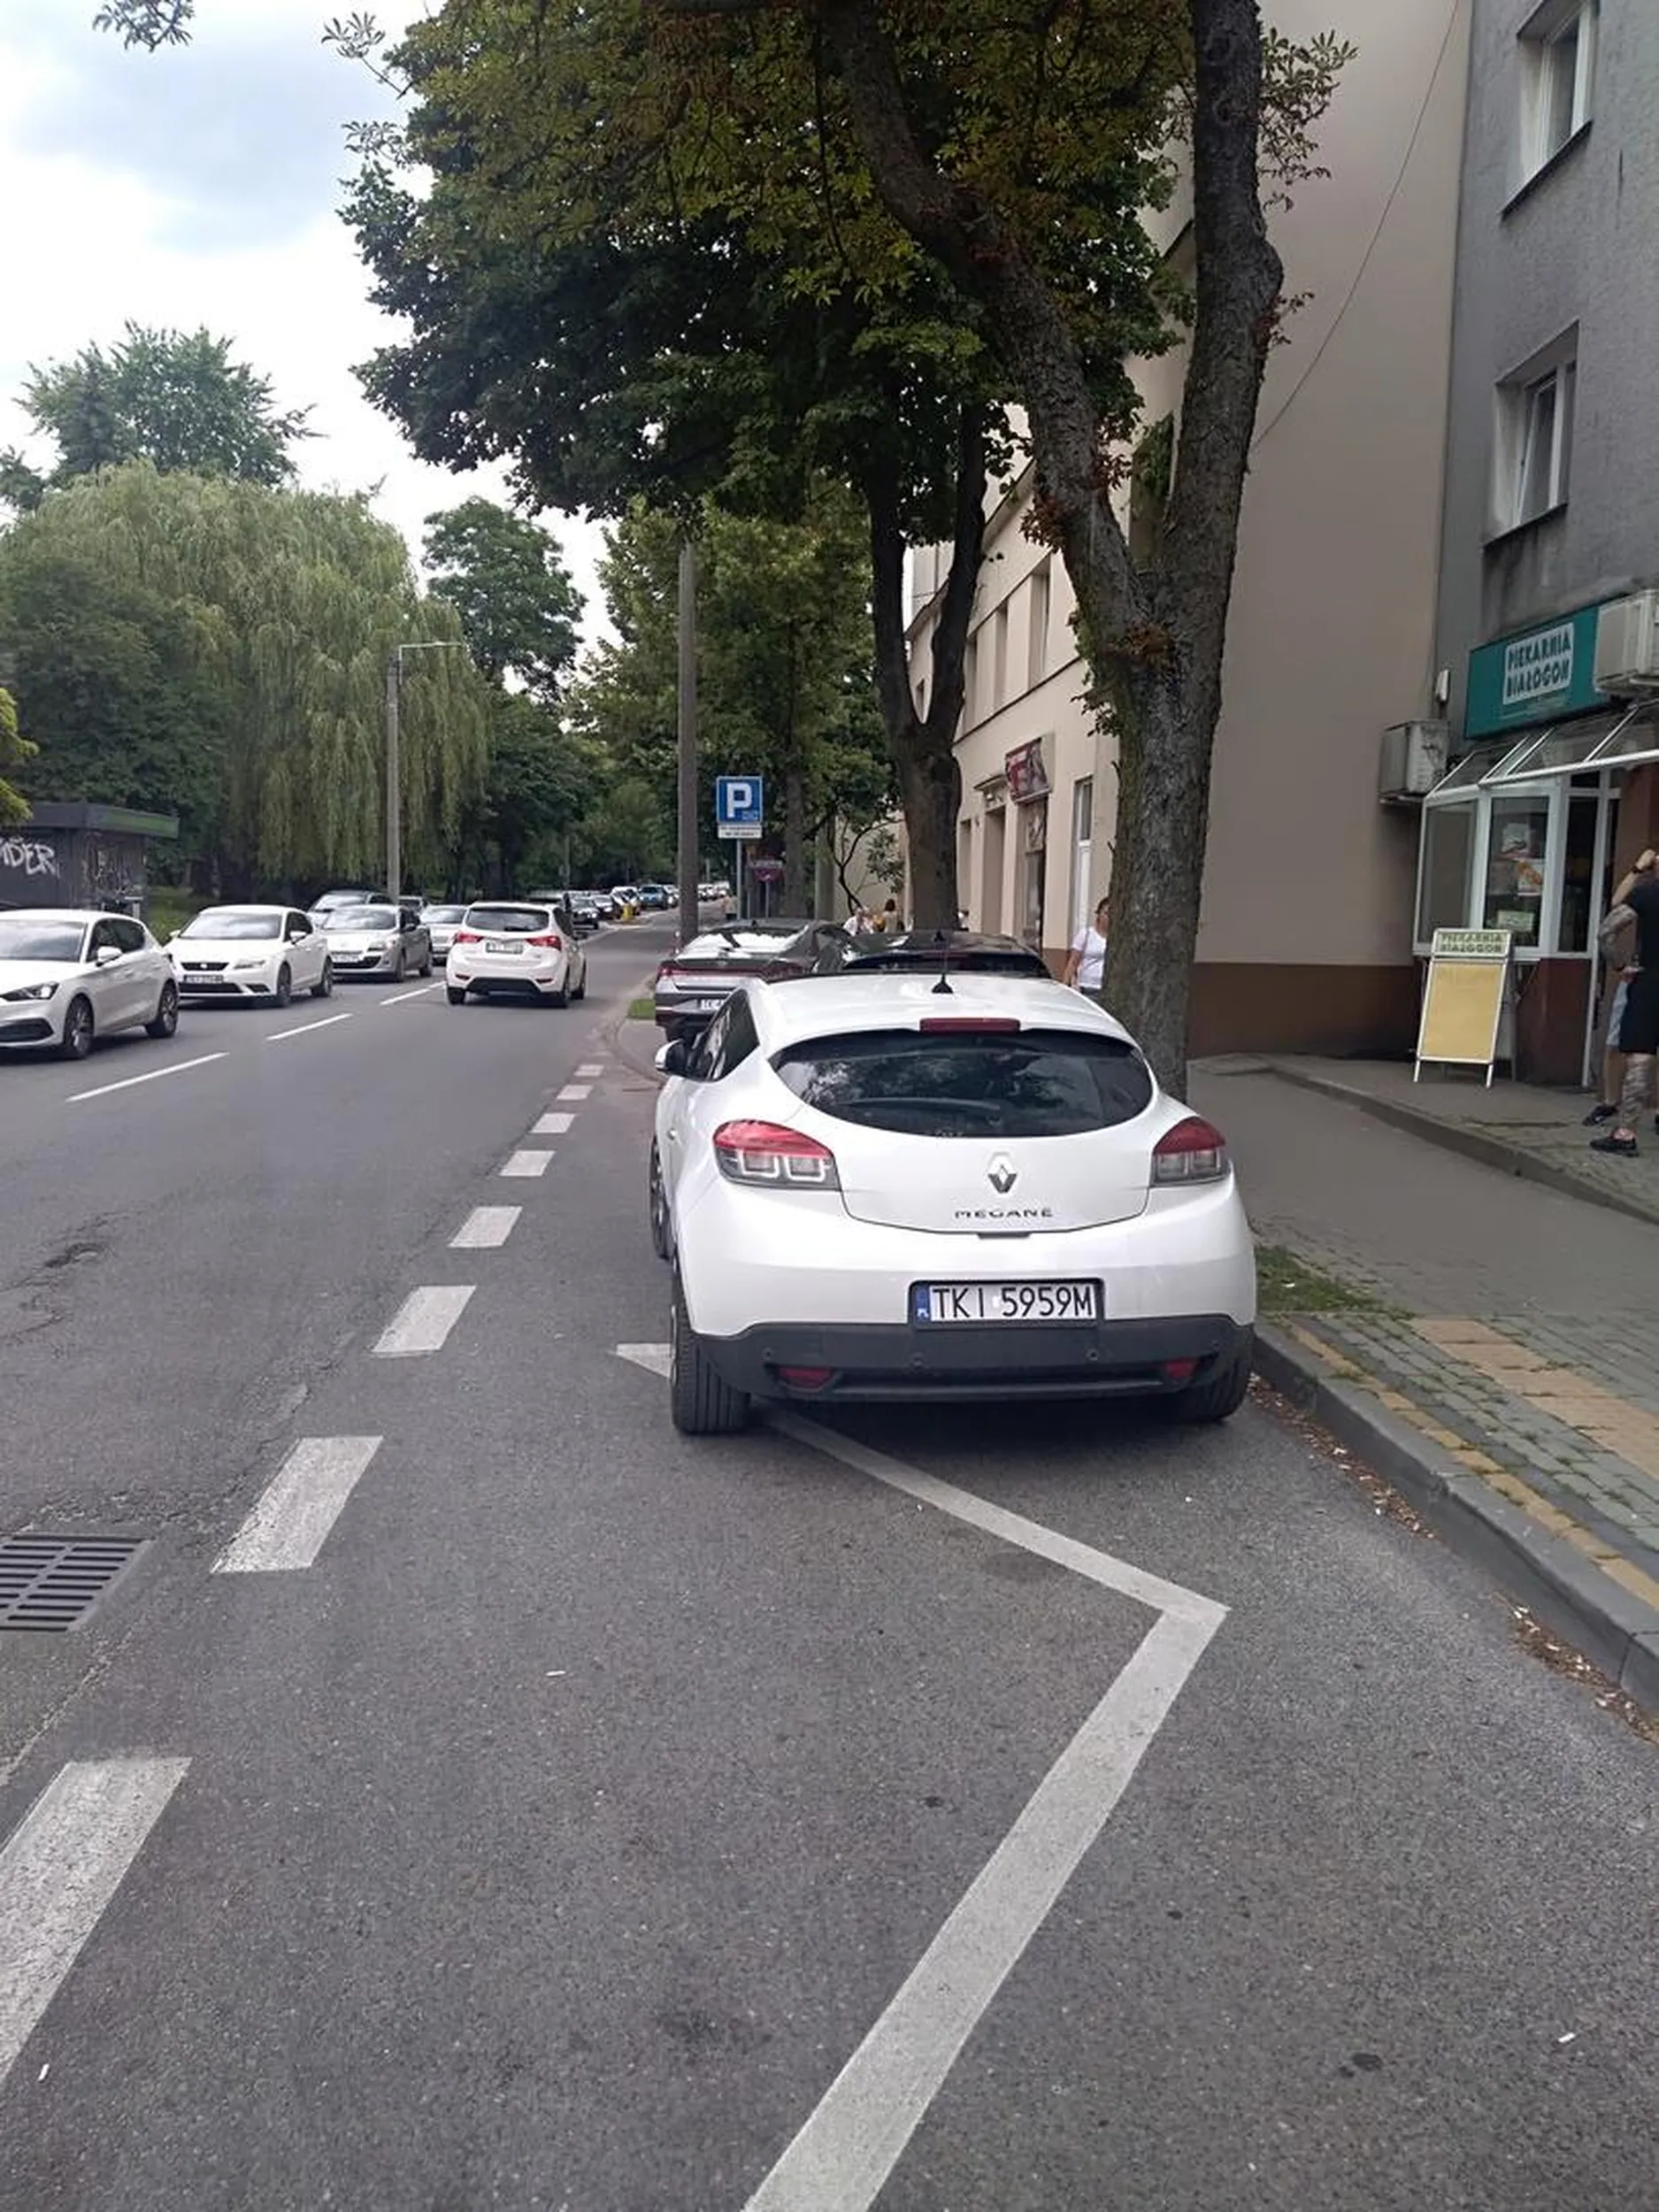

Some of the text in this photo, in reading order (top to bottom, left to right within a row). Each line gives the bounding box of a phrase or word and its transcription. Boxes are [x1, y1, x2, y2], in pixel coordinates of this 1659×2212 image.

[1507, 631, 1571, 670] PIEKARNIA
[726, 782, 752, 818] P
[956, 1208, 1053, 1218] MEGANE
[933, 1286, 1093, 1318] TKI 5959M
